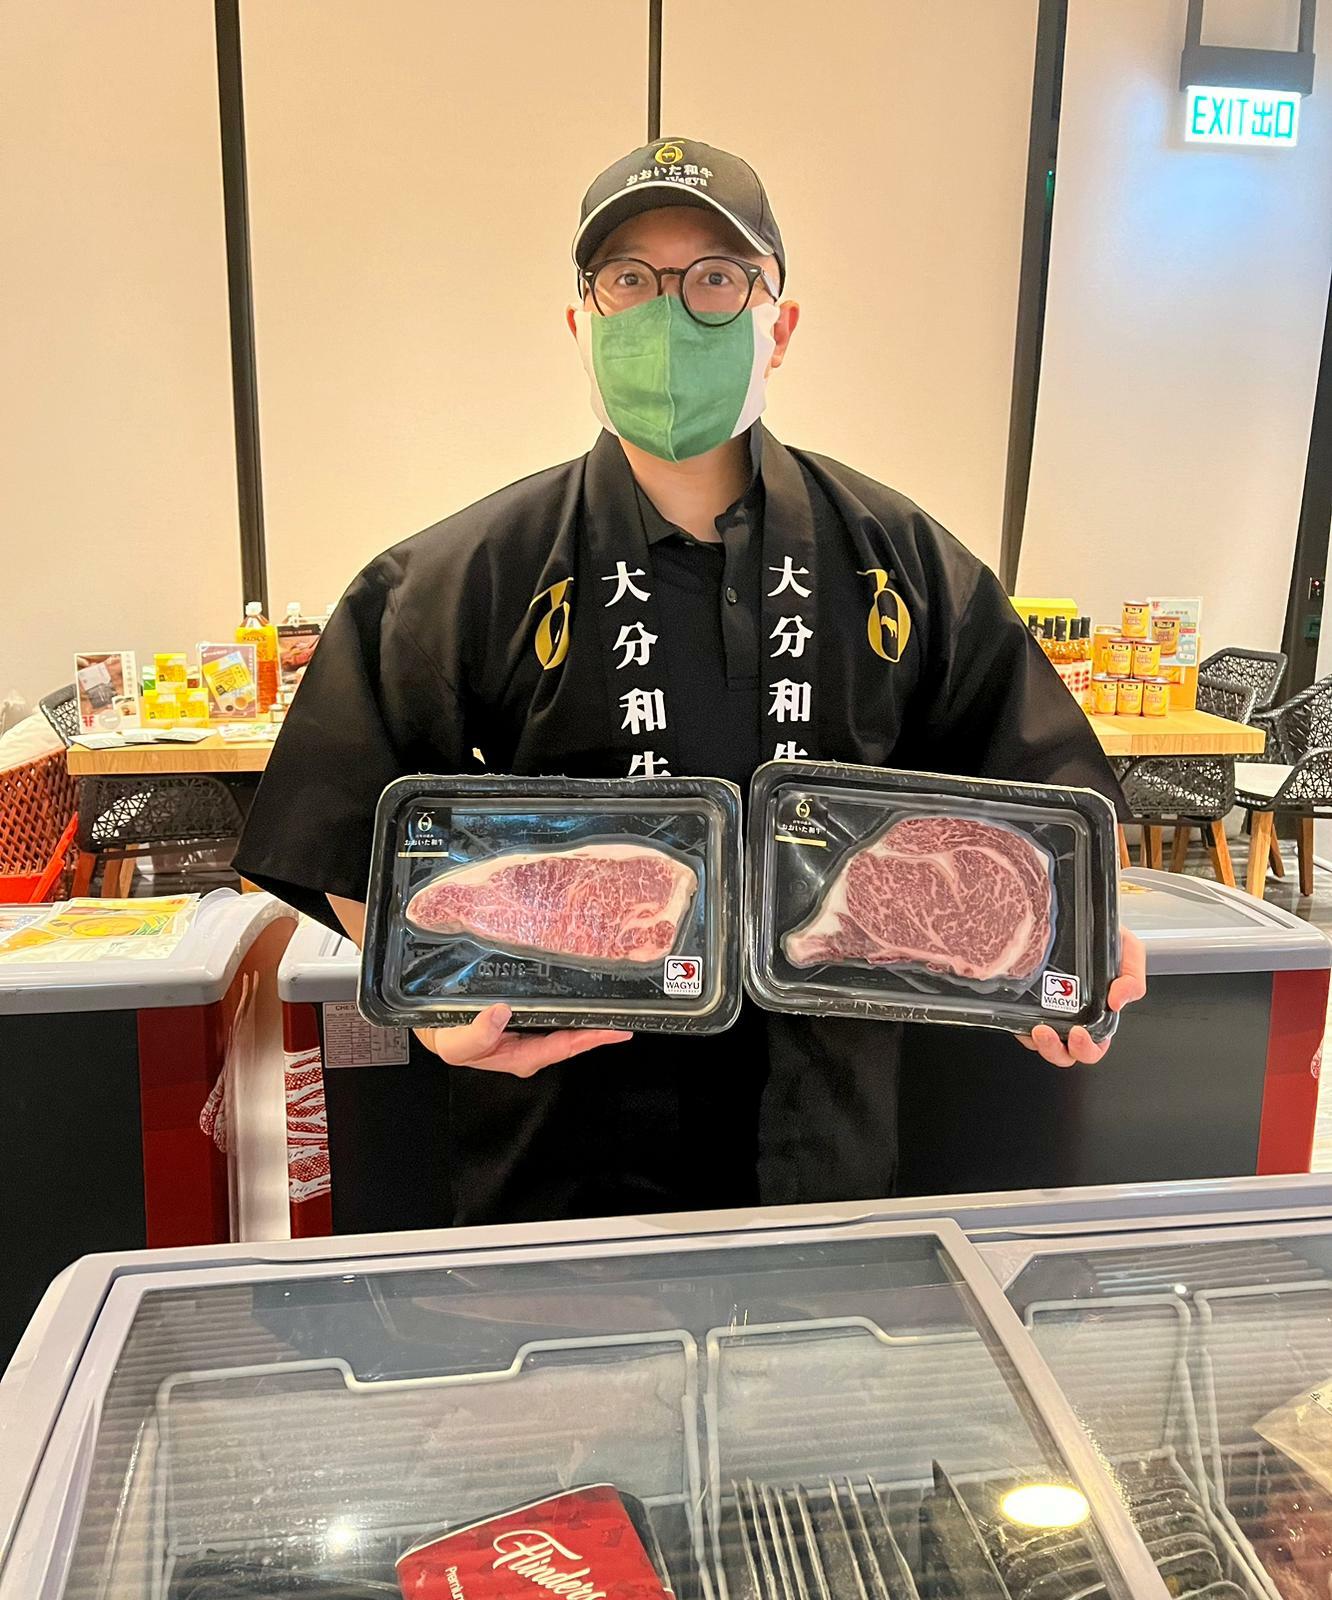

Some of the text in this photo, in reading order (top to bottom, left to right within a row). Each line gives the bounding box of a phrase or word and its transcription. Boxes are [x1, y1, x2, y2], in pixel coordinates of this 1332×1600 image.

[1192, 96, 1295, 138] EXIT 出口
[626, 163, 713, 186] おおいた和牛
[665, 981, 700, 990] WAGYU
[1043, 996, 1078, 1007] WAGYU
